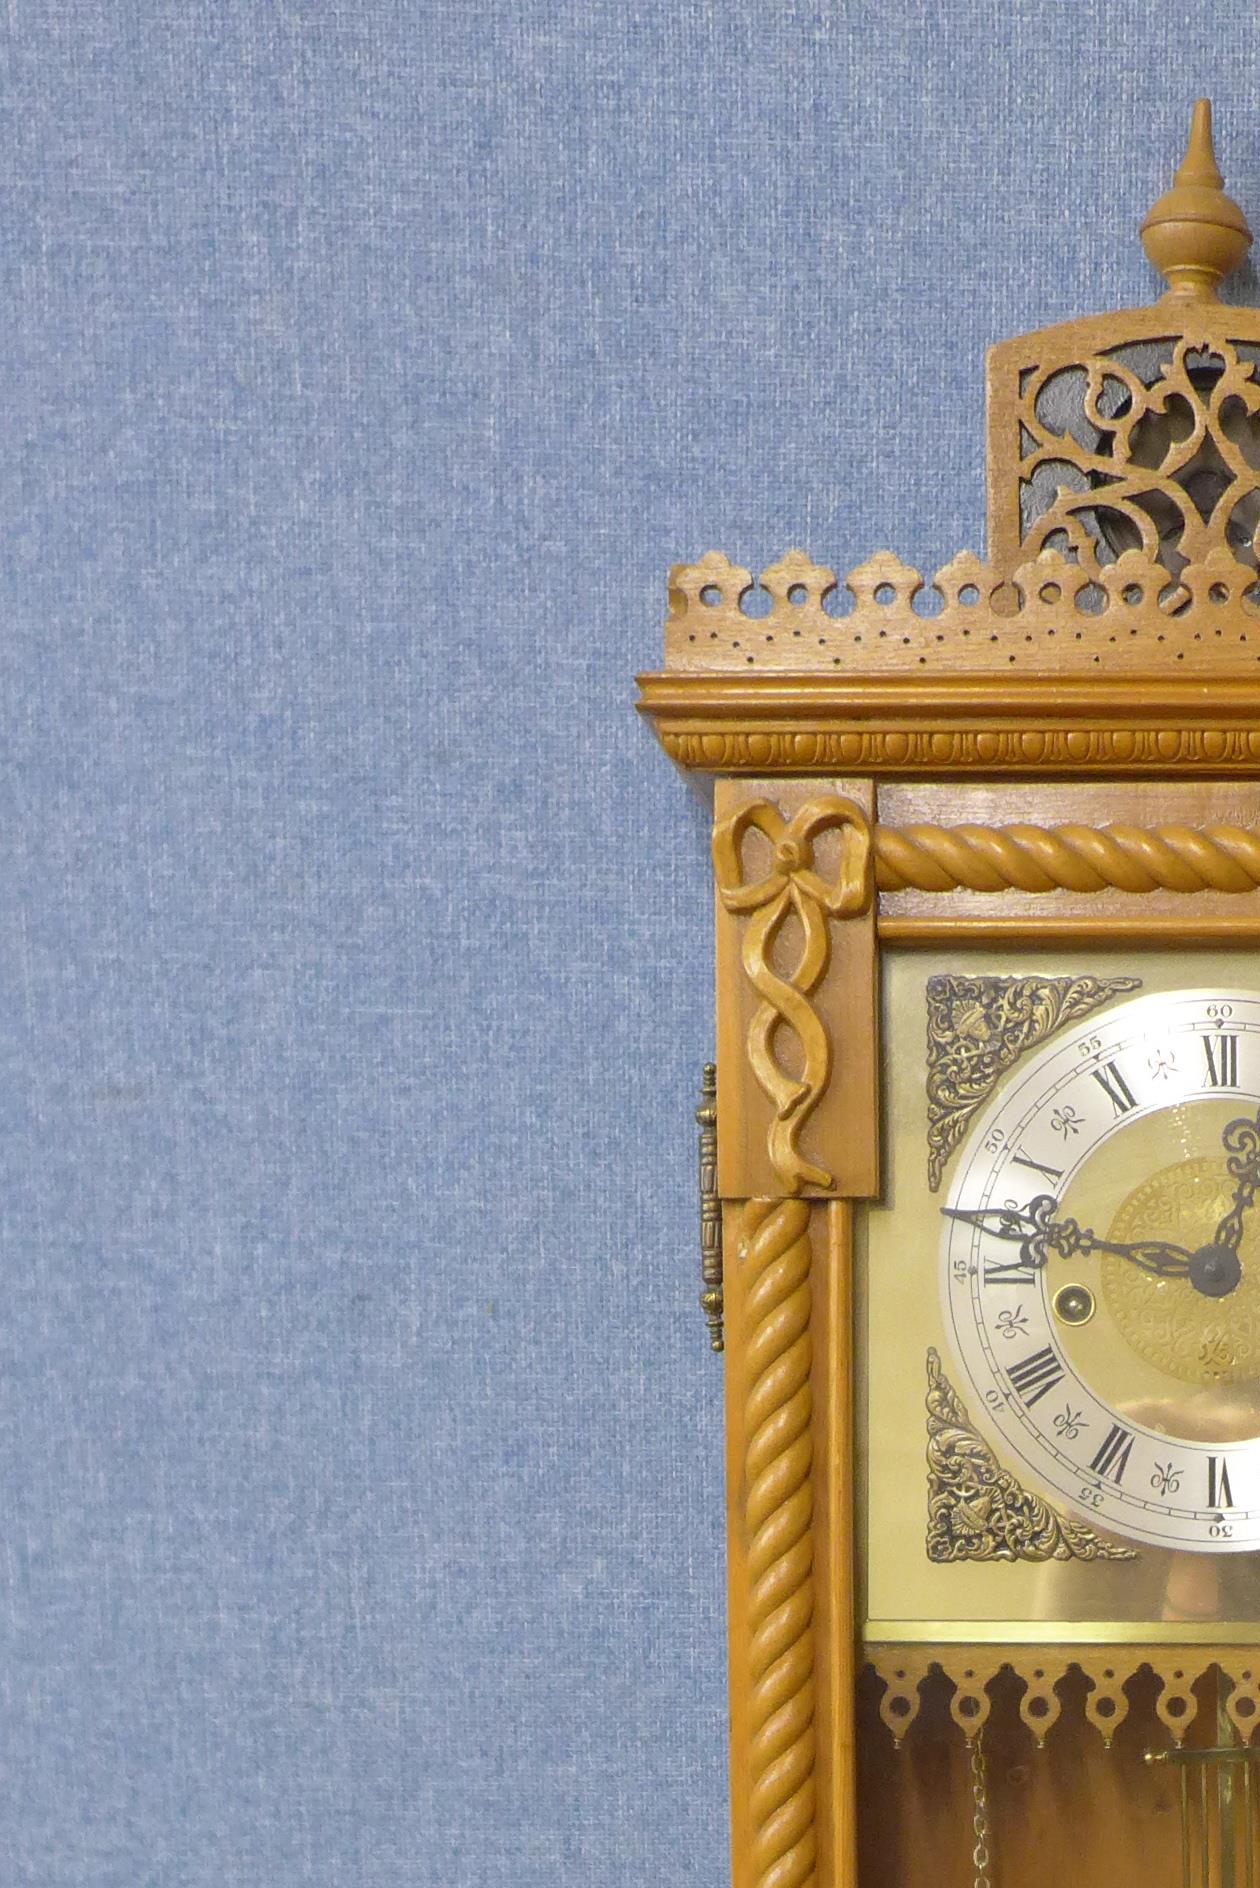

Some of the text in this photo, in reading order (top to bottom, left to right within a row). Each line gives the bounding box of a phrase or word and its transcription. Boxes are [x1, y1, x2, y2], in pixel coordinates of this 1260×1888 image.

[1206, 1004, 1233, 1018] 60
[1077, 1034, 1103, 1058] 55
[1201, 1034, 1240, 1088] XII
[1089, 1059, 1141, 1120] XI
[984, 1128, 1006, 1155] 50
[1010, 1144, 1065, 1190] X
[953, 1259, 968, 1286] 45
[1005, 1342, 1066, 1410] VIII
[985, 1389, 1006, 1414] 40
[1086, 1422, 1137, 1487] VII
[1206, 1456, 1235, 1509] VI
[1078, 1486, 1105, 1509] 35
[1208, 1524, 1234, 1538] 30
